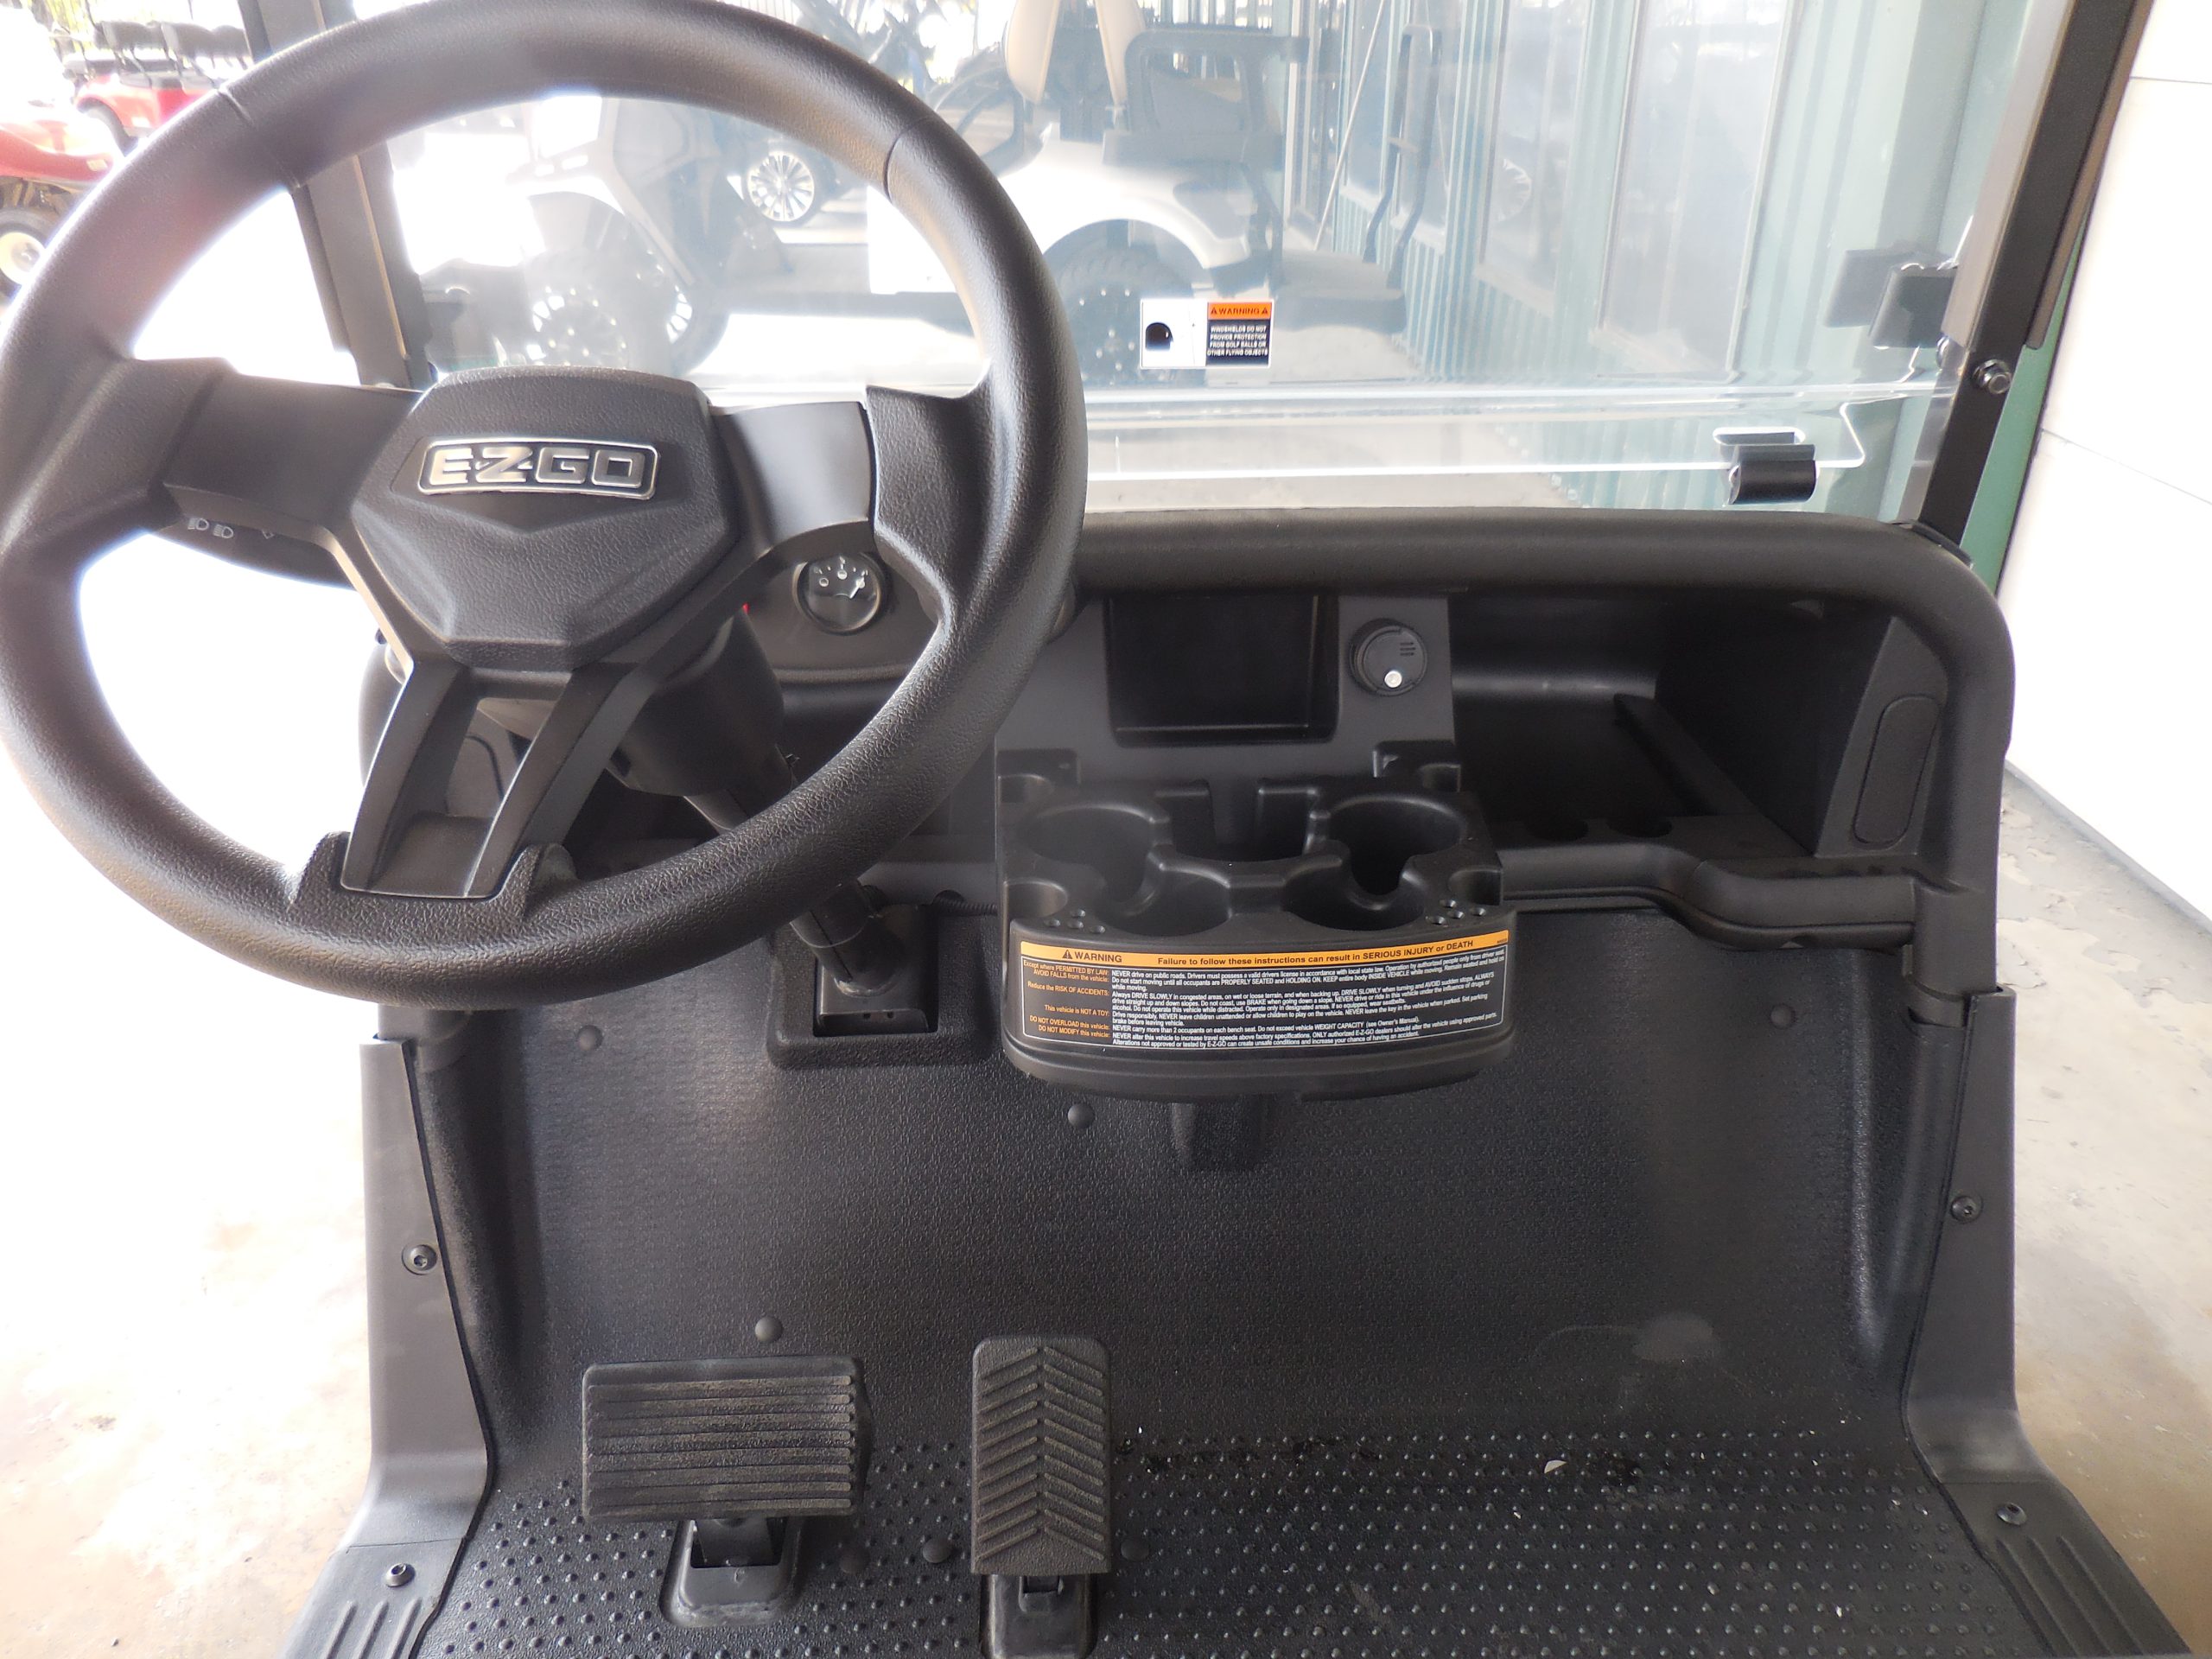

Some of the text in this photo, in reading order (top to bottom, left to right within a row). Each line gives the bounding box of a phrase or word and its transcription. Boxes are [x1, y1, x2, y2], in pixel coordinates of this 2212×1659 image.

[1219, 306, 1259, 315] WARNING
[1074, 951, 1122, 963] WARNING
[1255, 956, 1306, 964] instructions
[1363, 950, 1402, 960] SERIOUS
[1404, 946, 1434, 956] INJURY
[1446, 940, 1474, 950] DEATH
